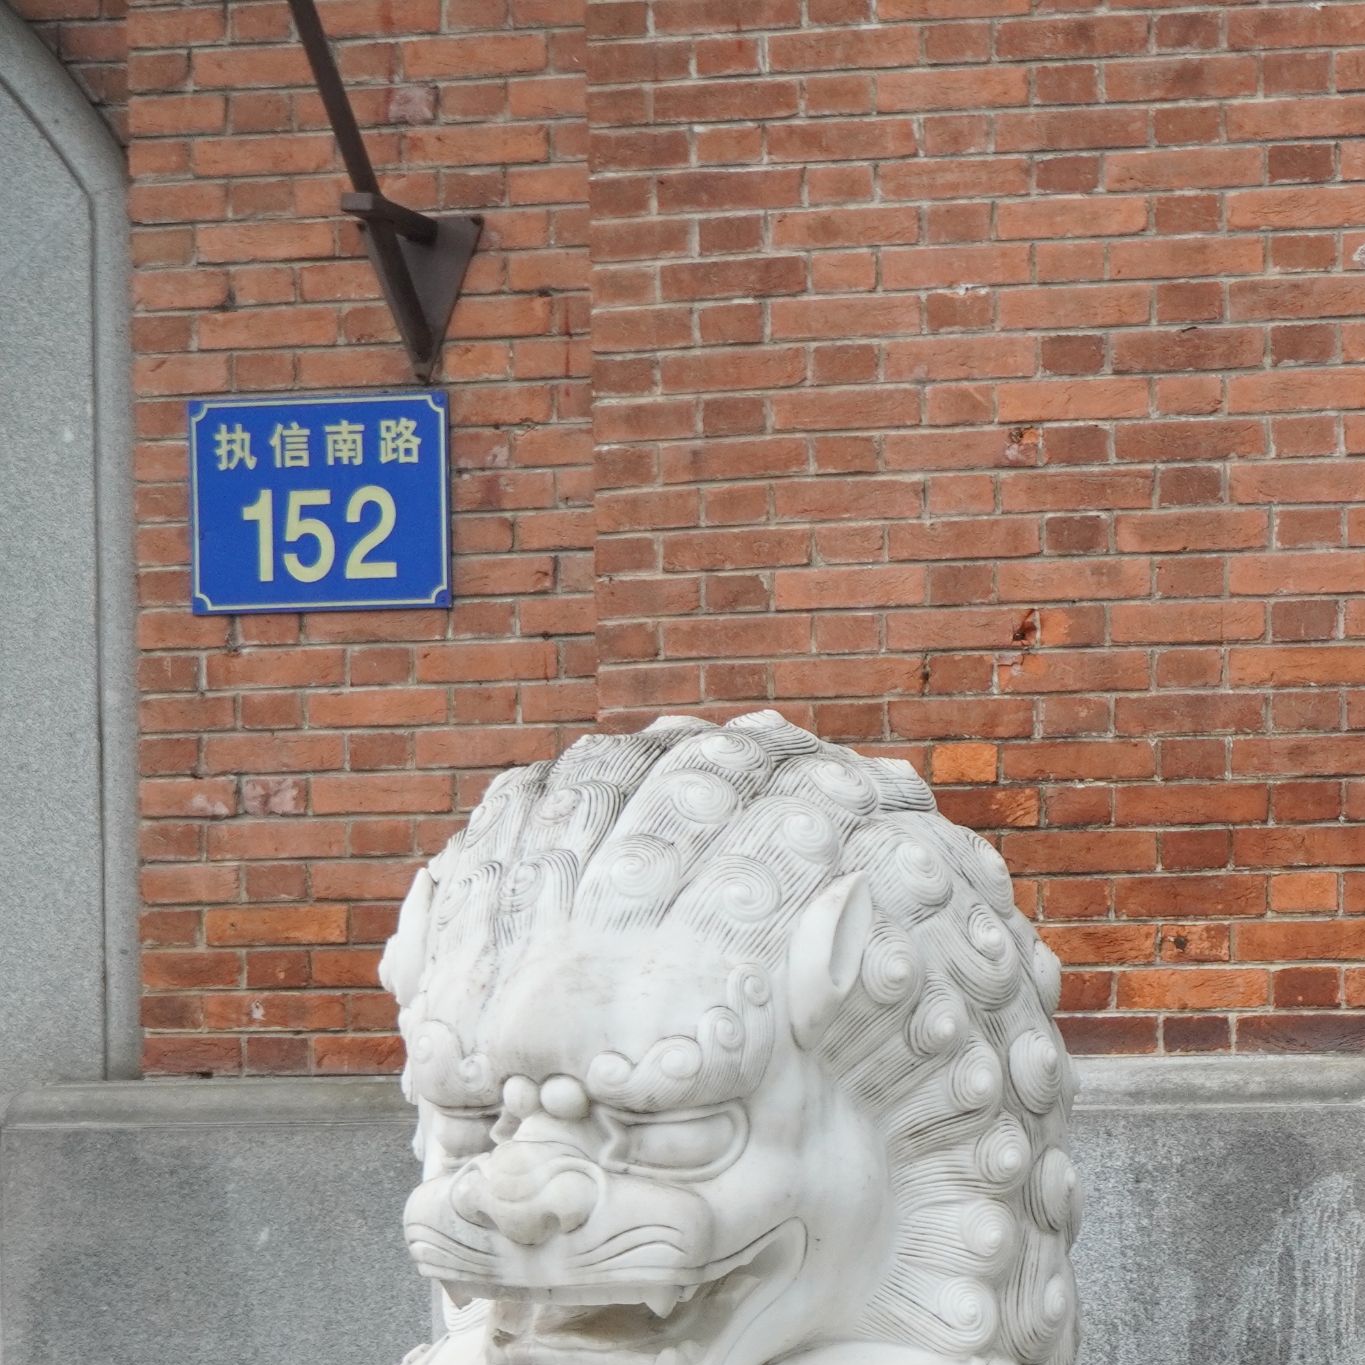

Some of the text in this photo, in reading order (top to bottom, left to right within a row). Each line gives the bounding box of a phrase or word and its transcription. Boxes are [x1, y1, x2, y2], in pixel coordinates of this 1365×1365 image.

[213, 417, 421, 471] 执信南路
[242, 485, 397, 583] 152
